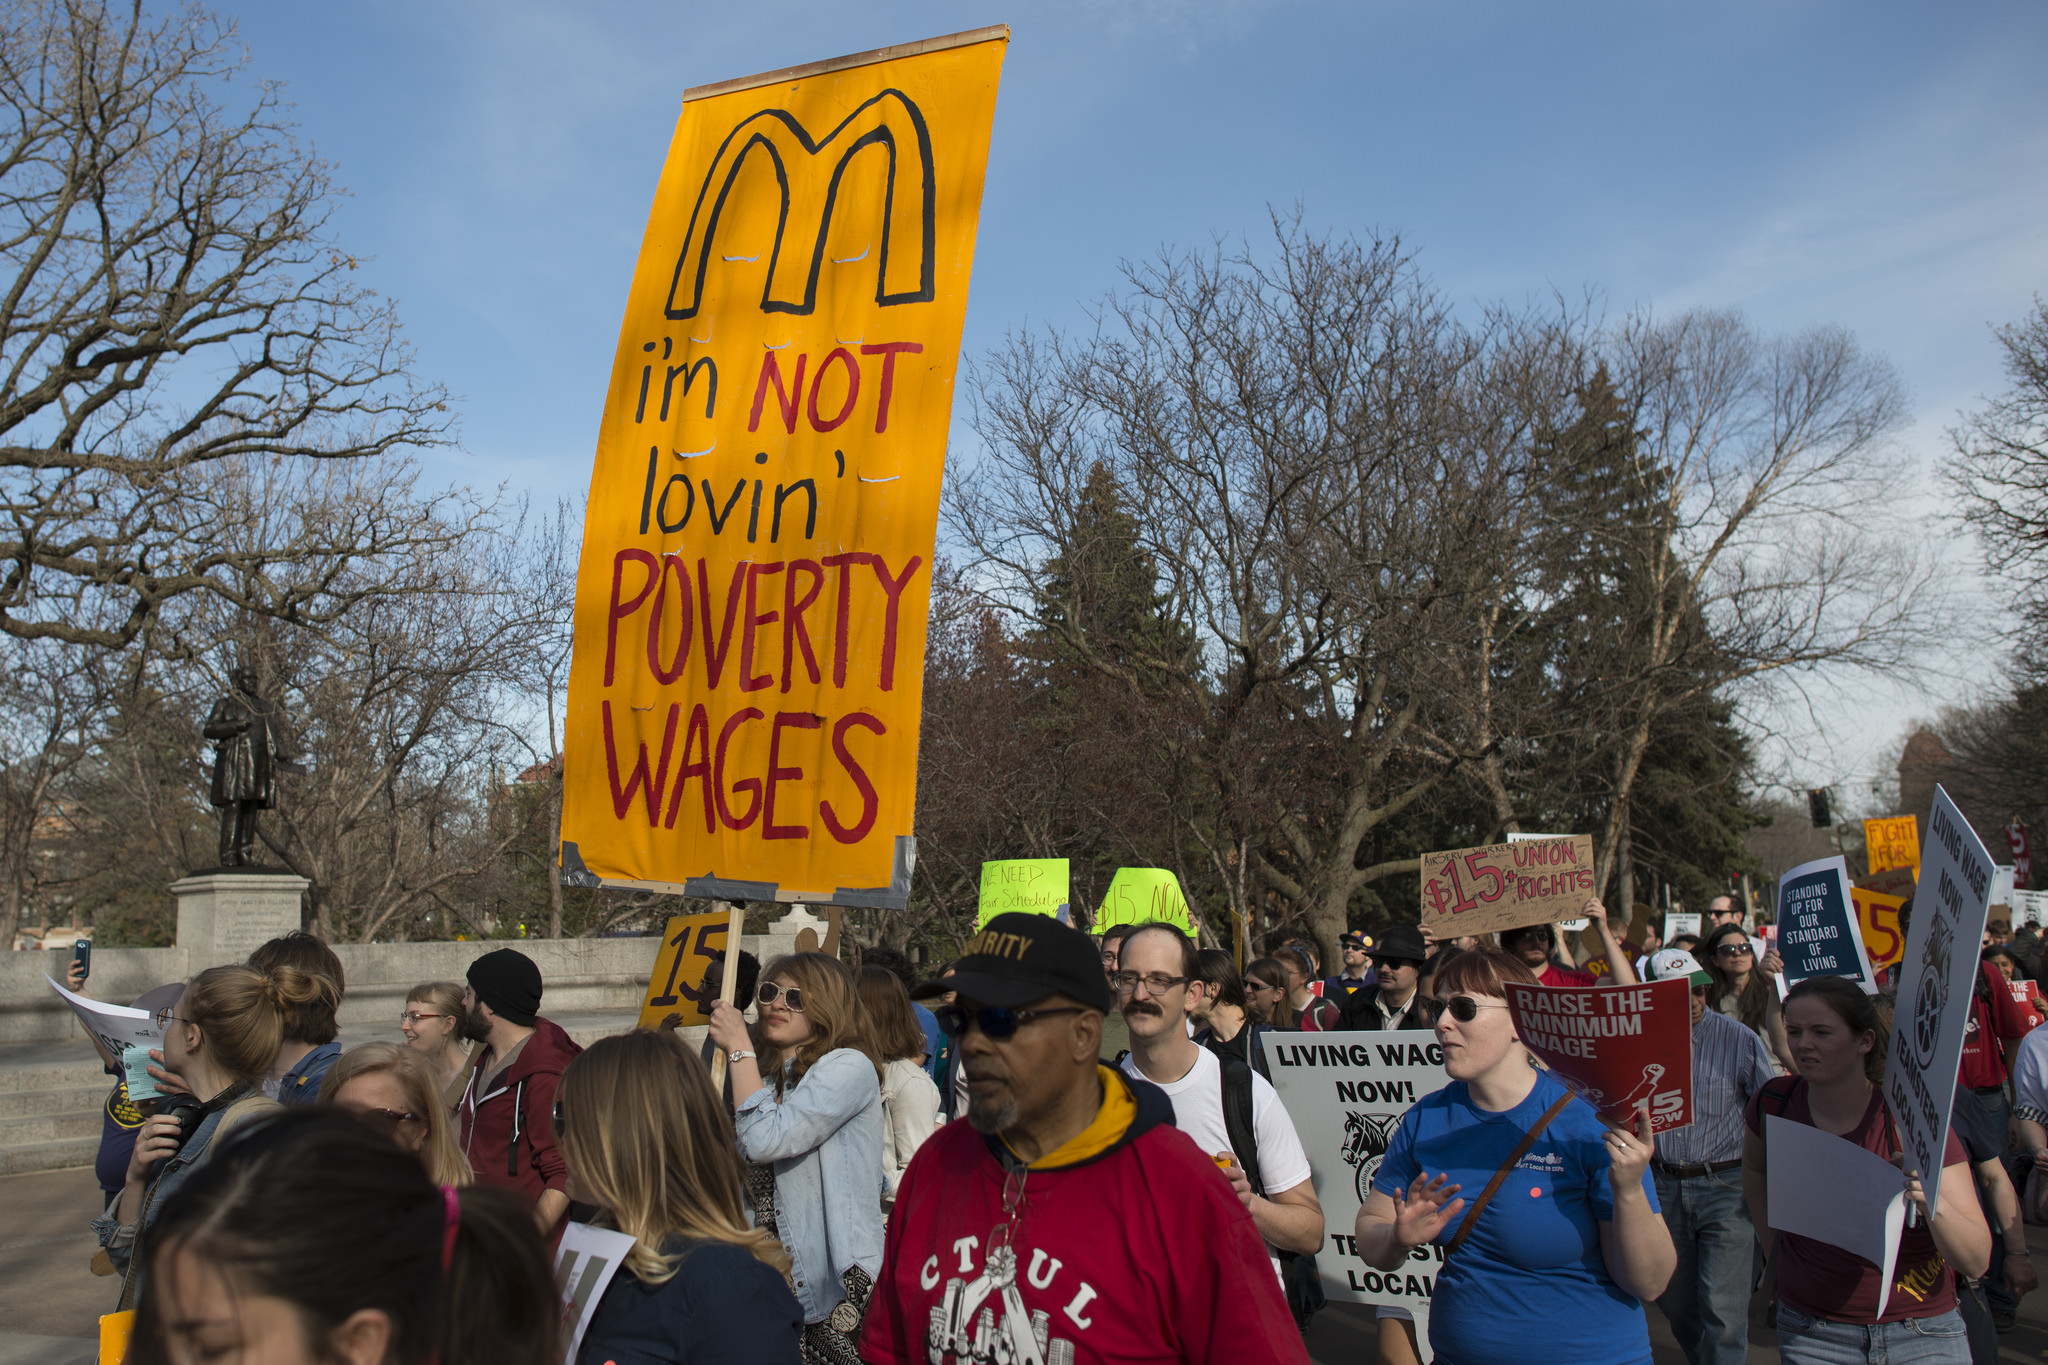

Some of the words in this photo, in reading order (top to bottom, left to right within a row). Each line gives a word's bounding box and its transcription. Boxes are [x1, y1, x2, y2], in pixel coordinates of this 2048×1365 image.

[635, 336, 718, 424] i'm
[747, 341, 924, 435] NOT
[639, 445, 845, 544] lovin'
[602, 548, 922, 694] POVERTY
[601, 700, 888, 845] WAGES
[1867, 821, 1916, 844] FIGHT
[1877, 844, 1910, 863] FOR
[1932, 803, 1962, 865] LIVING
[1961, 842, 1987, 905] WAGE
[1001, 864, 1044, 888] NEED
[1423, 849, 1505, 915] $15
[1513, 840, 1577, 868] UNION
[1516, 869, 1594, 901] RIGHTS
[1786, 882, 1828, 903] STANDING
[1937, 866, 1964, 925] NOW!
[1791, 902, 1802, 916] UP
[1805, 898, 1824, 914] FOR
[1799, 913, 1819, 928] OUR
[1786, 925, 1839, 945] STANDARD
[1808, 943, 1821, 956] OF
[1802, 955, 1838, 972] LIVING
[1515, 989, 1595, 1015] RAISE
[1600, 988, 1654, 1014] THE
[1519, 1010, 1643, 1038] MINIMUM
[1276, 1044, 1371, 1067] LIVING
[1376, 1043, 1445, 1067] WAG
[1523, 1027, 1598, 1059] WAGE
[1335, 1080, 1417, 1104] NOW!
[1896, 1027, 1940, 1143] TEAMSTERS
[1891, 1072, 1916, 1145] LOCAL
[1915, 1129, 1931, 1181] 320
